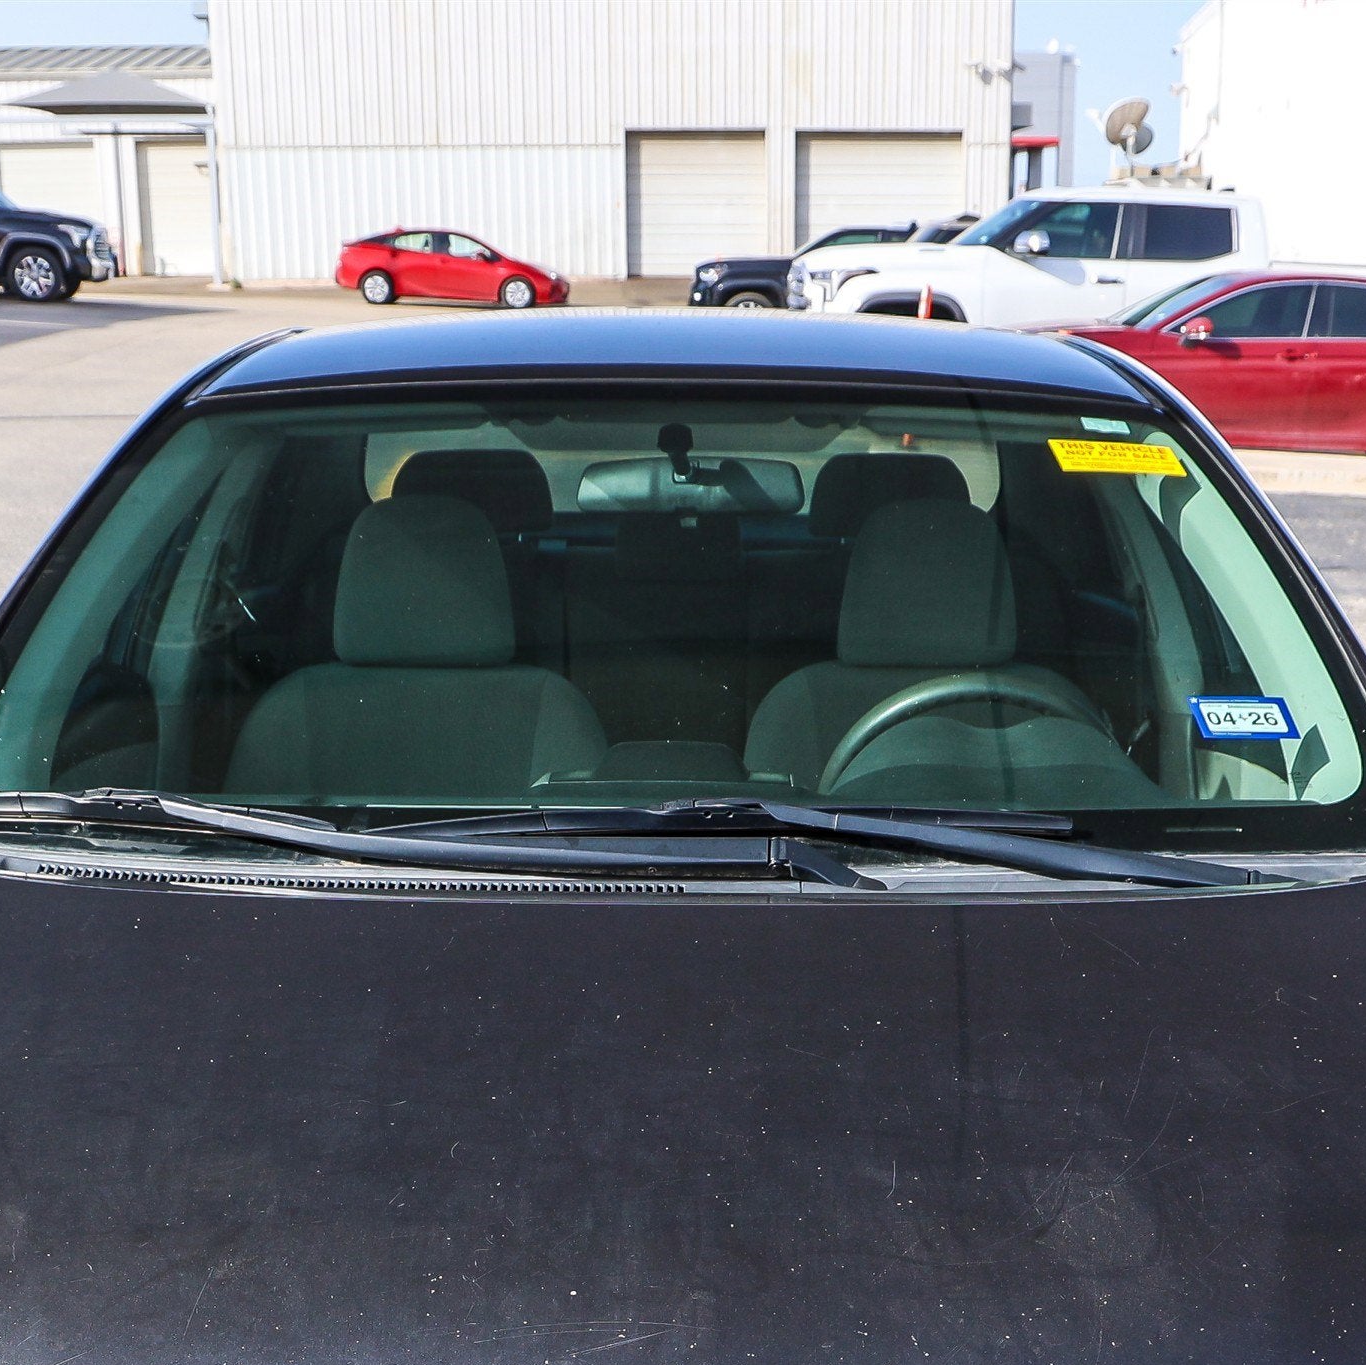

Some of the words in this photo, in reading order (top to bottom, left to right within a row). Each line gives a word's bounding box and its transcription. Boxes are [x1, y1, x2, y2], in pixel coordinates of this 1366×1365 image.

[1056, 441, 1095, 450] THIS
[1098, 443, 1168, 454] VEHICLE
[1132, 452, 1168, 461] SALE
[1207, 711, 1237, 725] 04
[1248, 711, 1278, 726] 26
